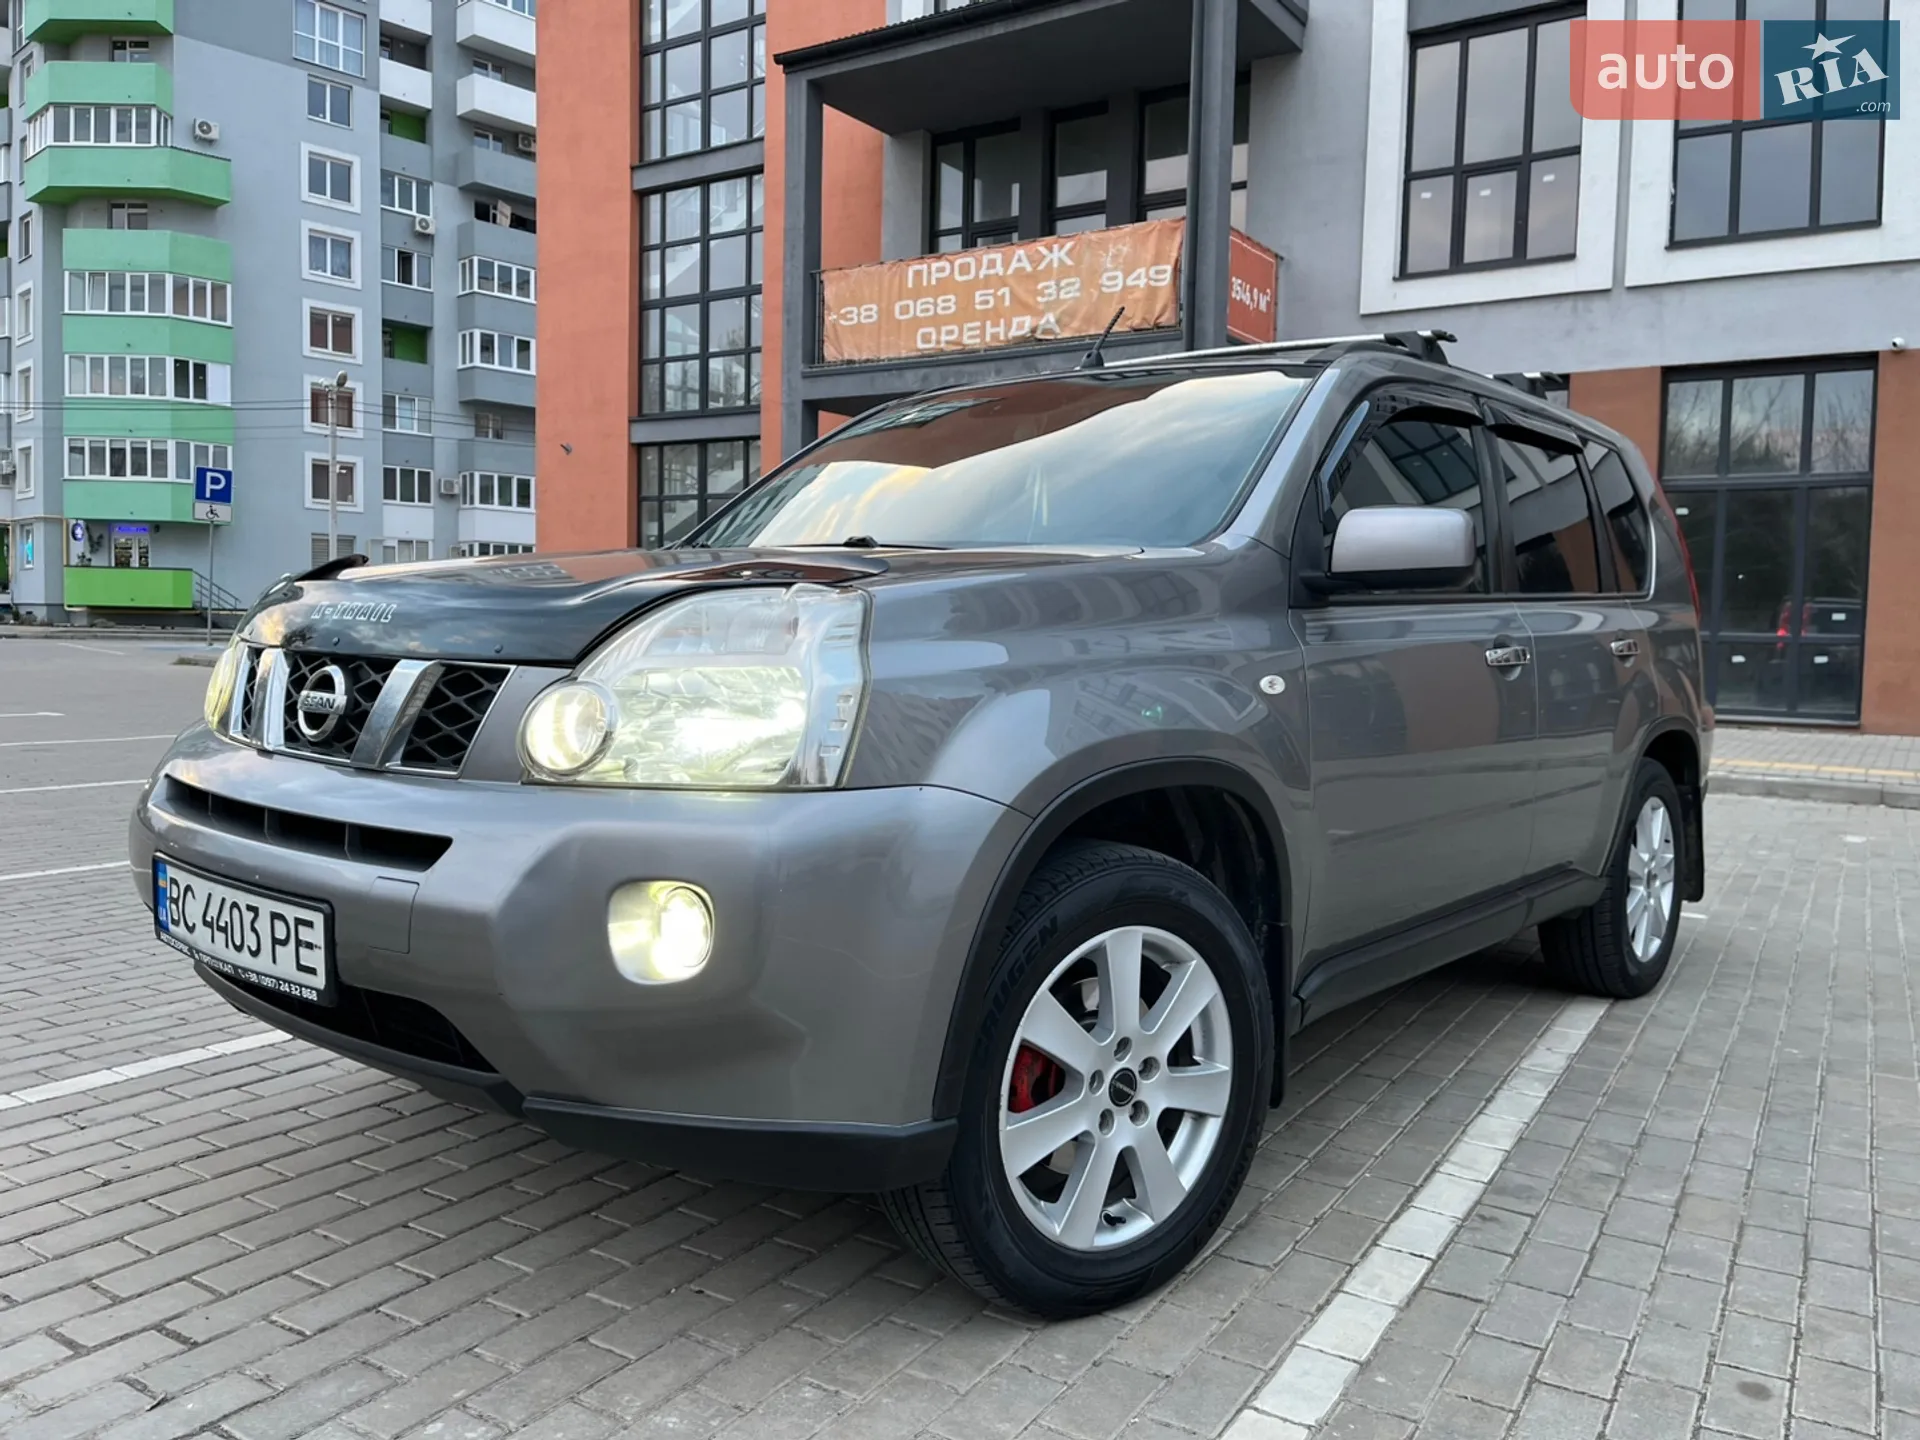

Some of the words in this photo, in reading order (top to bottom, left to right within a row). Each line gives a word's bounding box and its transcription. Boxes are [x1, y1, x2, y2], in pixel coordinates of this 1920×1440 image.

[907, 241, 1076, 288] ПРОДАЖ
[894, 294, 956, 321] 068
[974, 287, 1012, 311] 51
[1036, 278, 1081, 302] 32
[1101, 265, 1172, 293] 949
[916, 313, 1062, 349] ОРЕНДА
[205, 471, 226, 499] P
[311, 601, 397, 623] X-TRAIL
[169, 877, 196, 934] BC
[202, 892, 261, 958] 4403
[270, 910, 318, 976] PE
